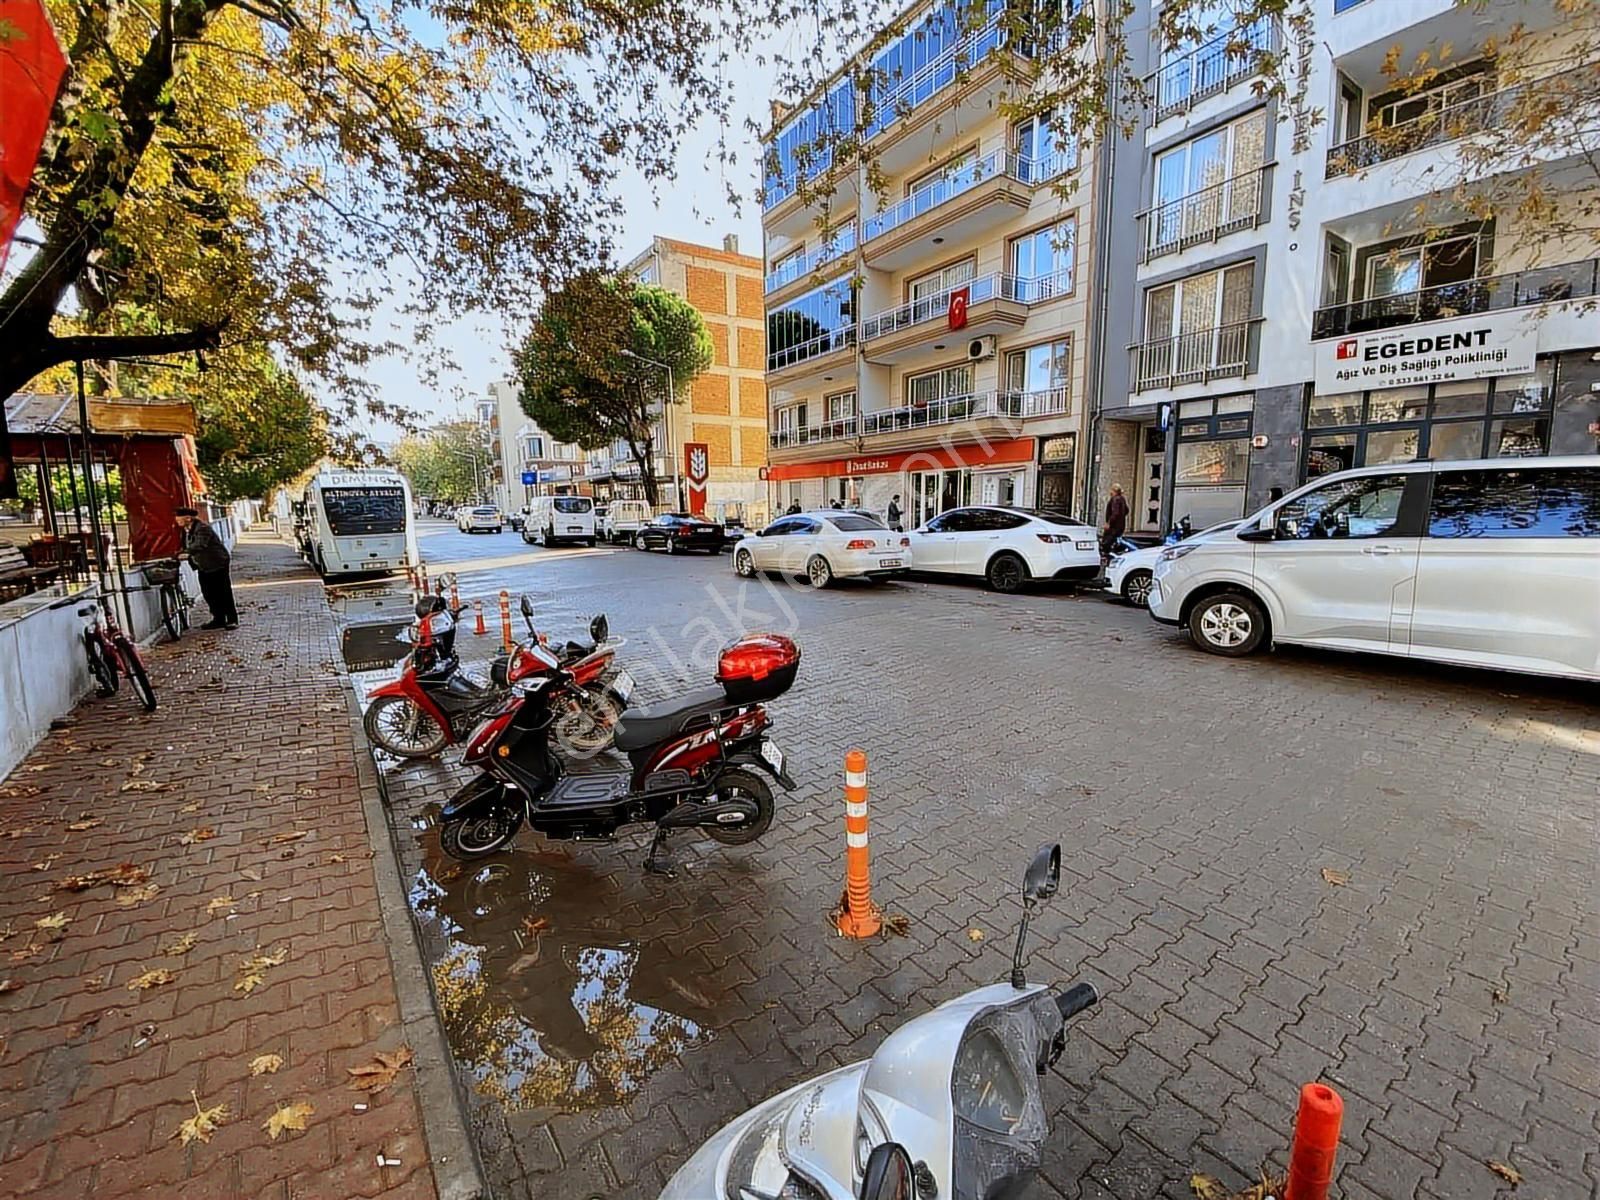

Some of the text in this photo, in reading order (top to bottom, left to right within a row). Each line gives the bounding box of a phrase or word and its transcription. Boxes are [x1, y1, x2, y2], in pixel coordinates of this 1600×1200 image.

[1363, 329, 1493, 362] EGEDENT
[1336, 348, 1509, 381] Ağız Ve Diş Sağlığı Polikliniği
